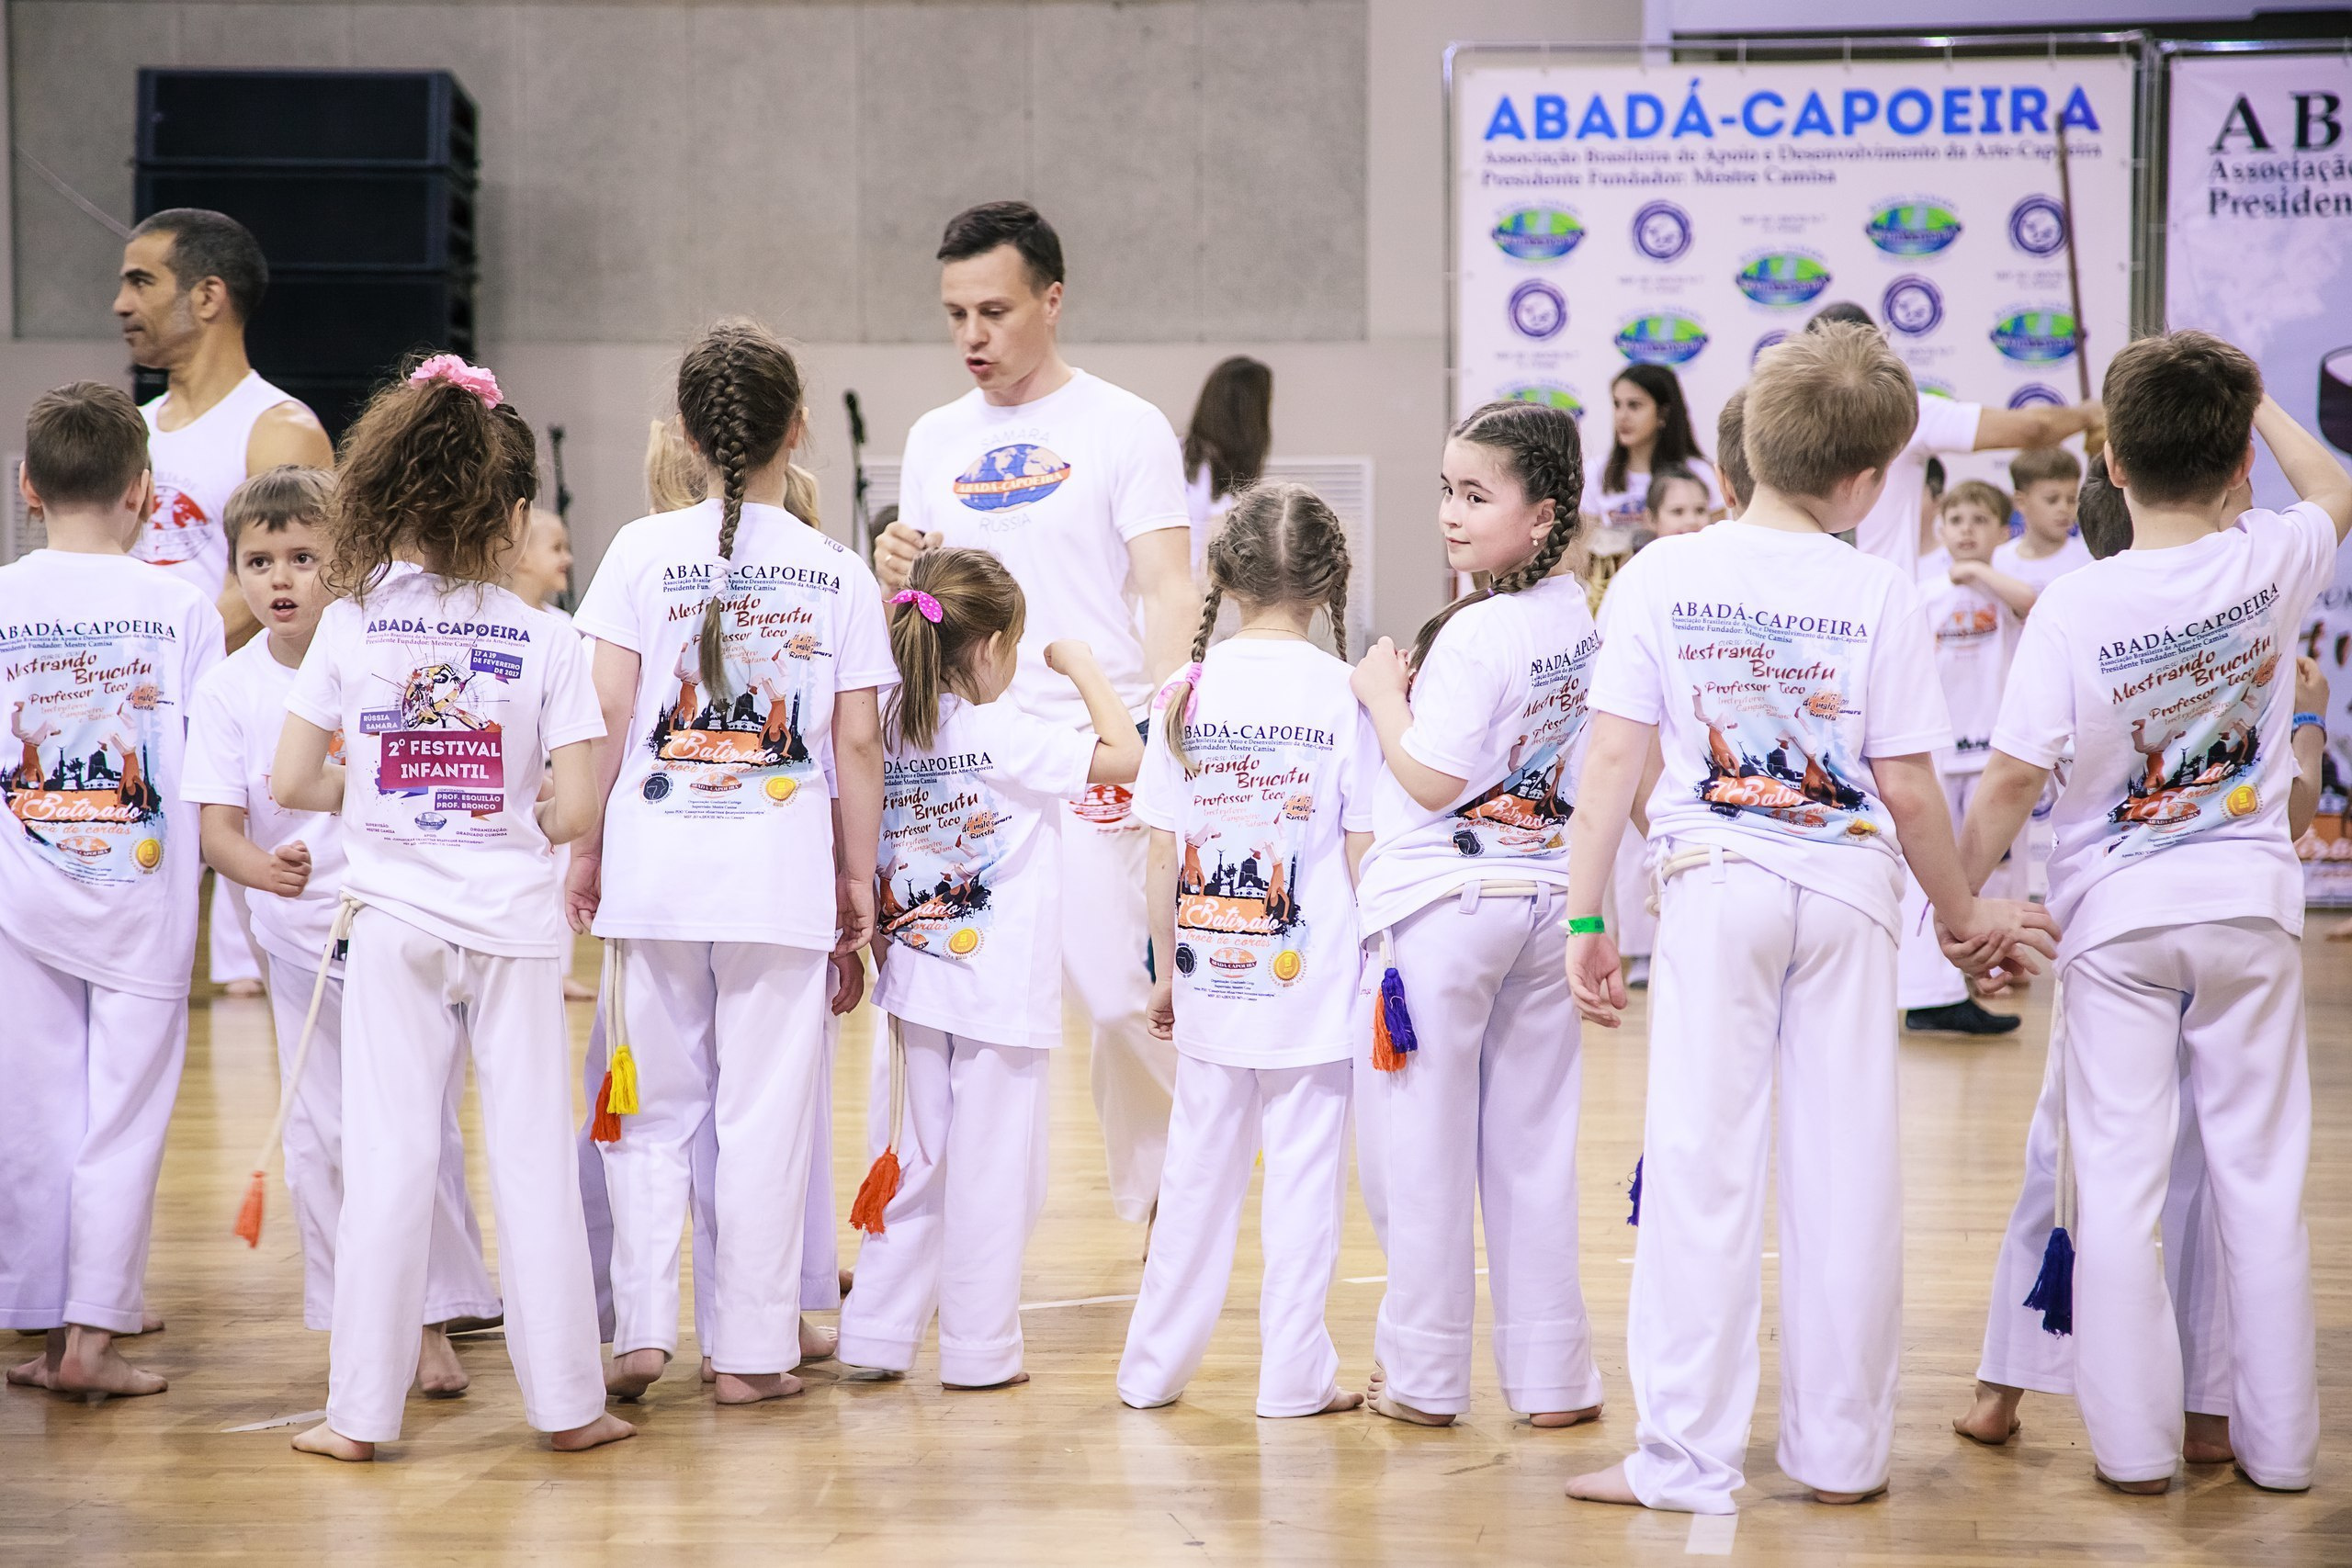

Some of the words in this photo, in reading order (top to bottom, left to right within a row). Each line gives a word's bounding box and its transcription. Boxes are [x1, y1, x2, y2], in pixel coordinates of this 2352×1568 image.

[1485, 77, 2101, 140] ABADÁ-CAPOEIRA
[663, 563, 840, 590] ABA-CAPOEIRA
[669, 593, 761, 622] Mestando
[1671, 601, 1868, 637] ABADÁ-CAPOEIRA
[367, 617, 530, 643] ABADÁ-CAPOEIRA
[2098, 582, 2278, 661] ABADÁ-CAPOEIRA
[483, 659, 521, 671] FEVEREIRO
[2101, 660, 2139, 674] Presidente
[2178, 642, 2202, 655] Mestre
[2203, 632, 2229, 645] Camisa
[2190, 635, 2271, 687] Brucutu
[504, 669, 520, 677] 2017
[1748, 659, 1836, 680] Brucutu
[2112, 649, 2216, 705] Mestrando
[28, 688, 94, 705] Professor
[1704, 681, 1771, 695] Professor
[2149, 686, 2219, 719] Professor
[366, 721, 399, 730] SAMARA
[1184, 720, 1335, 746] BADÁ-CAPOEIRA
[410, 739, 501, 758] FESTIVAL
[401, 762, 490, 780] INFANTIL
[884, 751, 992, 774] DÁ-CAPOEIRA
[461, 802, 496, 810] BRONCO
[911, 792, 978, 820] Brucutu
[1193, 793, 1253, 807] Professor
[883, 824, 932, 840] Professor
